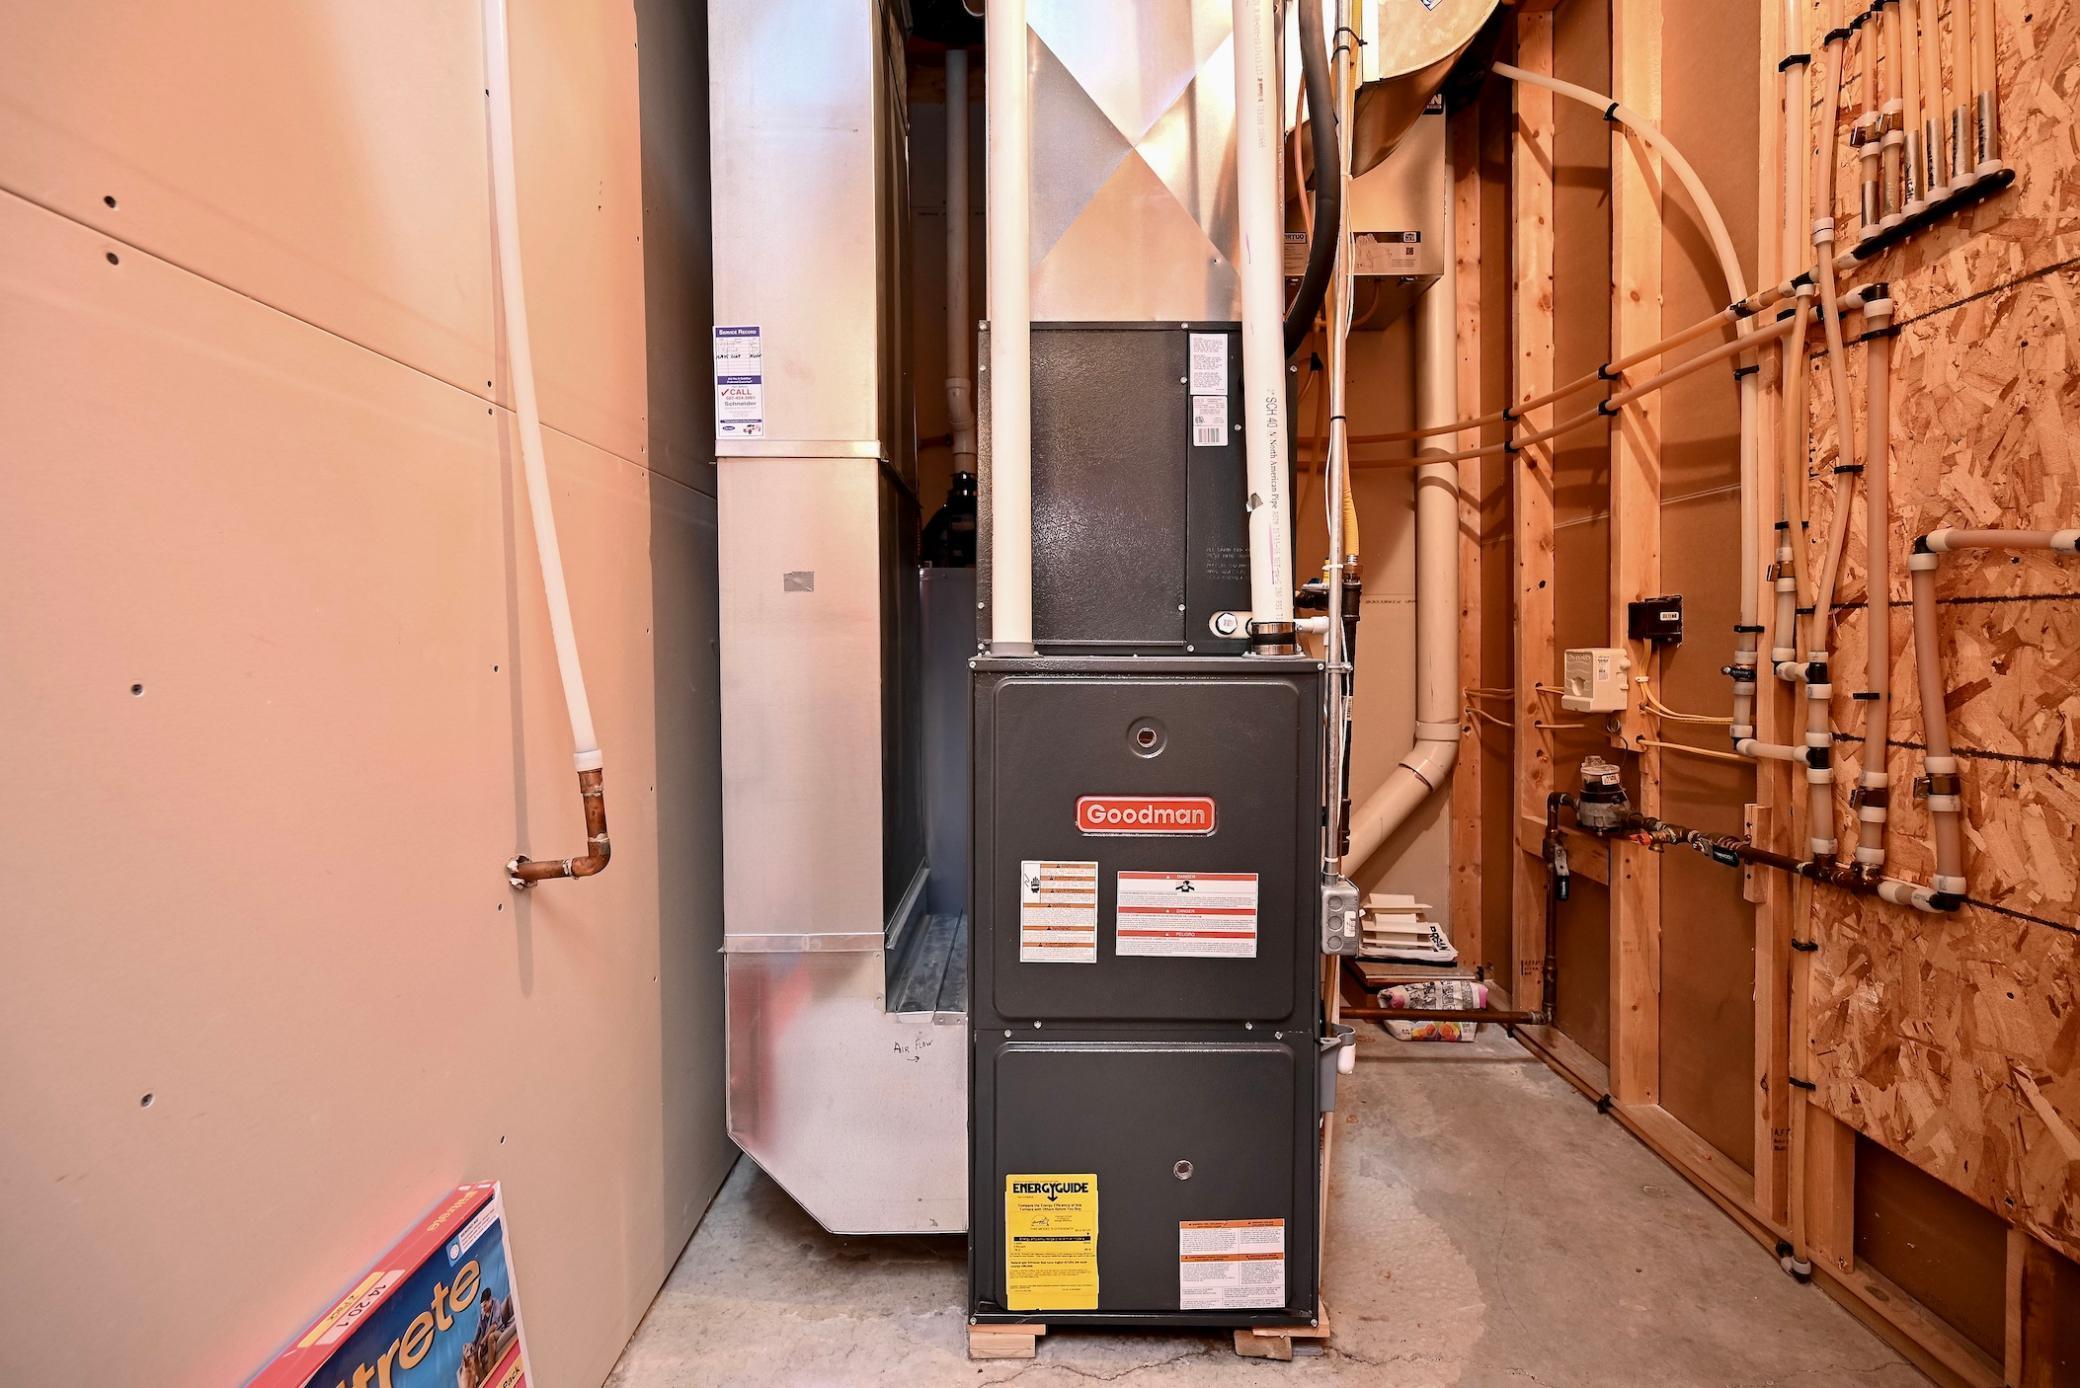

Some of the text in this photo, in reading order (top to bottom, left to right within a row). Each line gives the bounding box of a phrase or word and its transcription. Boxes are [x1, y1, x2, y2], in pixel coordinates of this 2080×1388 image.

[1265, 397, 1278, 416] SCH
[1269, 439, 1277, 459] North
[1269, 460, 1279, 493] American
[1087, 804, 1205, 824] Goodman
[893, 1041, 910, 1054] AIR
[1013, 1182, 1089, 1196] ENERGYGUIDE
[368, 1284, 386, 1297] 14
[348, 1301, 370, 1317] 20
[340, 1259, 482, 1388] trete
